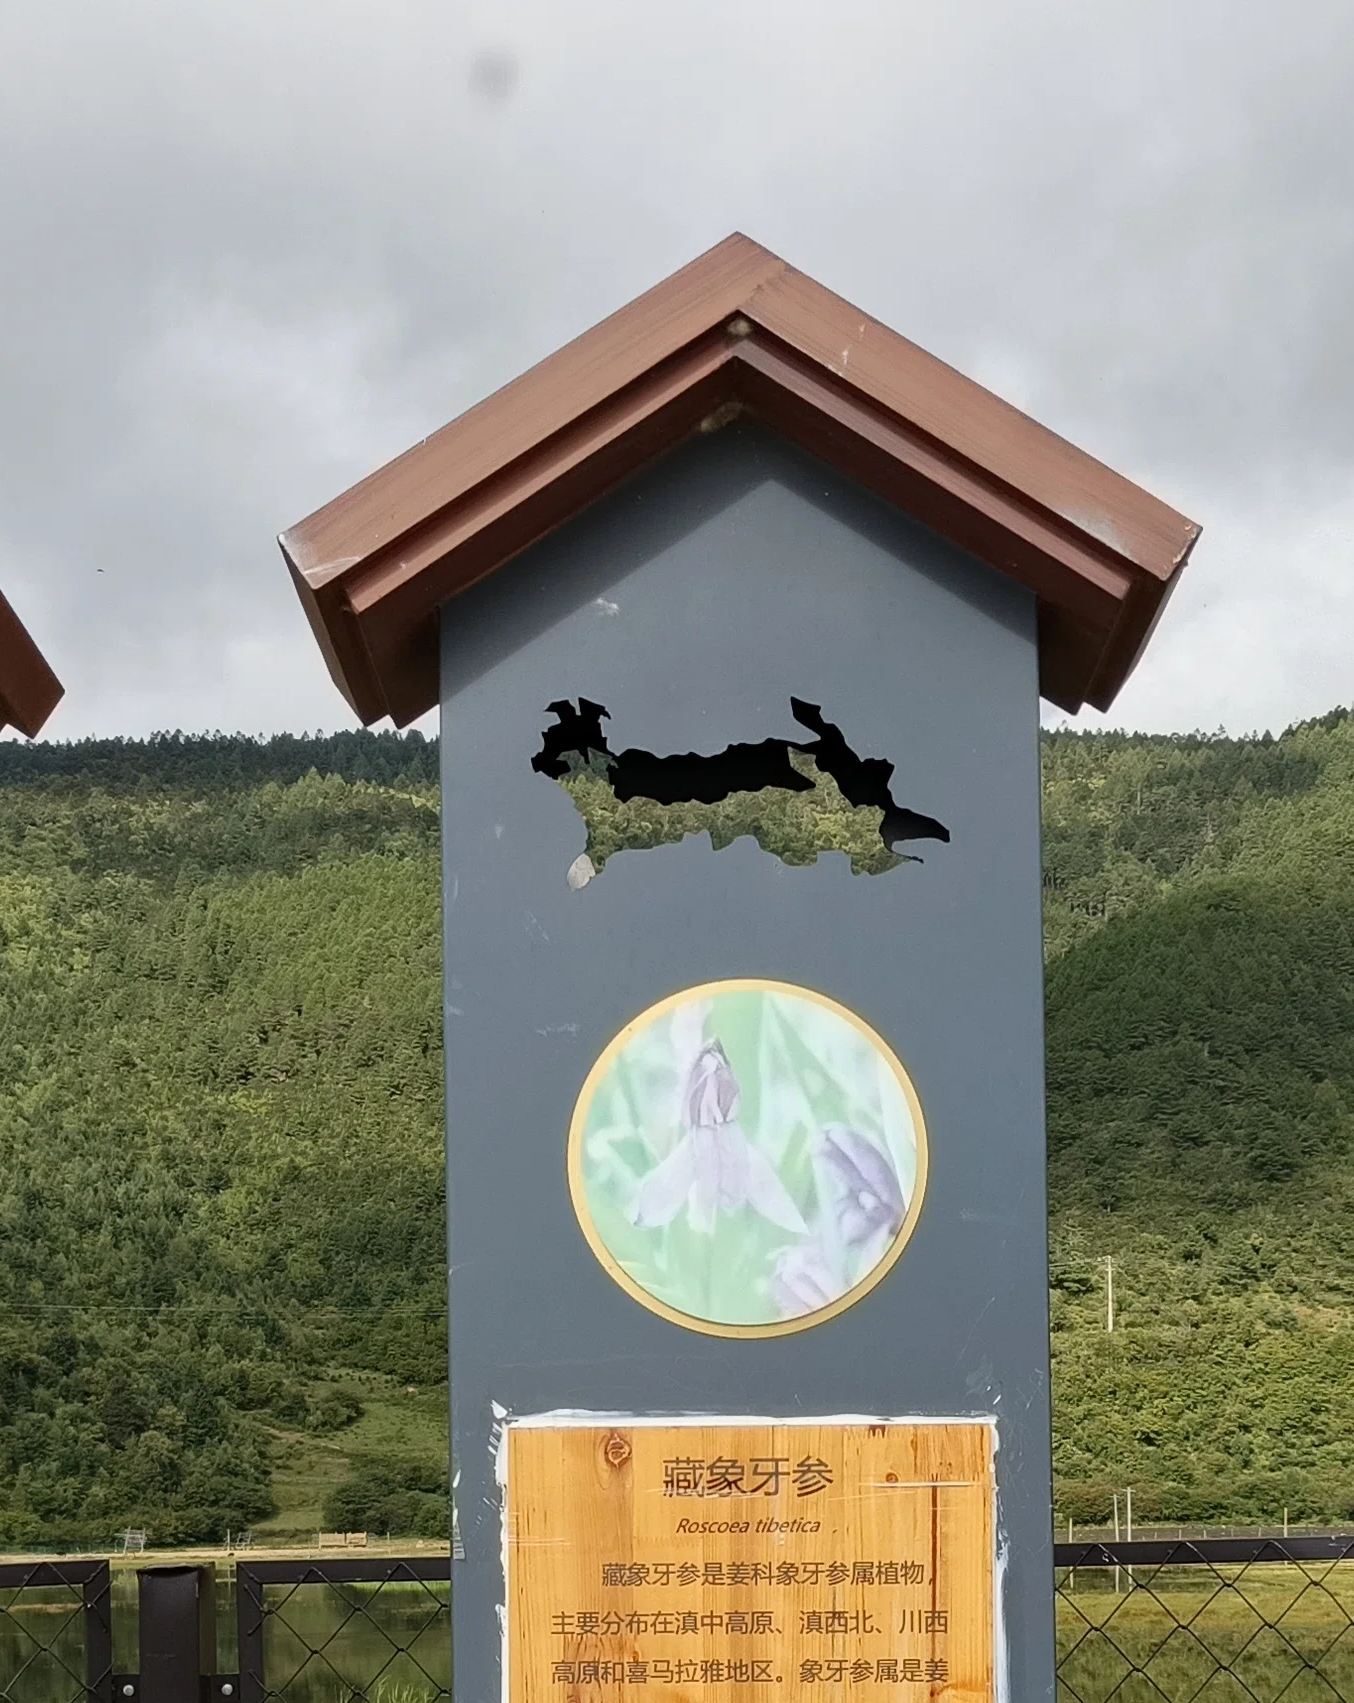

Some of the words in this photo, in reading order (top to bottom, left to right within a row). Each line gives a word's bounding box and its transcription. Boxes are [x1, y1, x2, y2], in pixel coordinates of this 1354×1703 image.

[662, 1456, 834, 1498] 藏象牙参
[676, 1518, 751, 1535] Roscoea
[755, 1518, 821, 1534] tibetica
